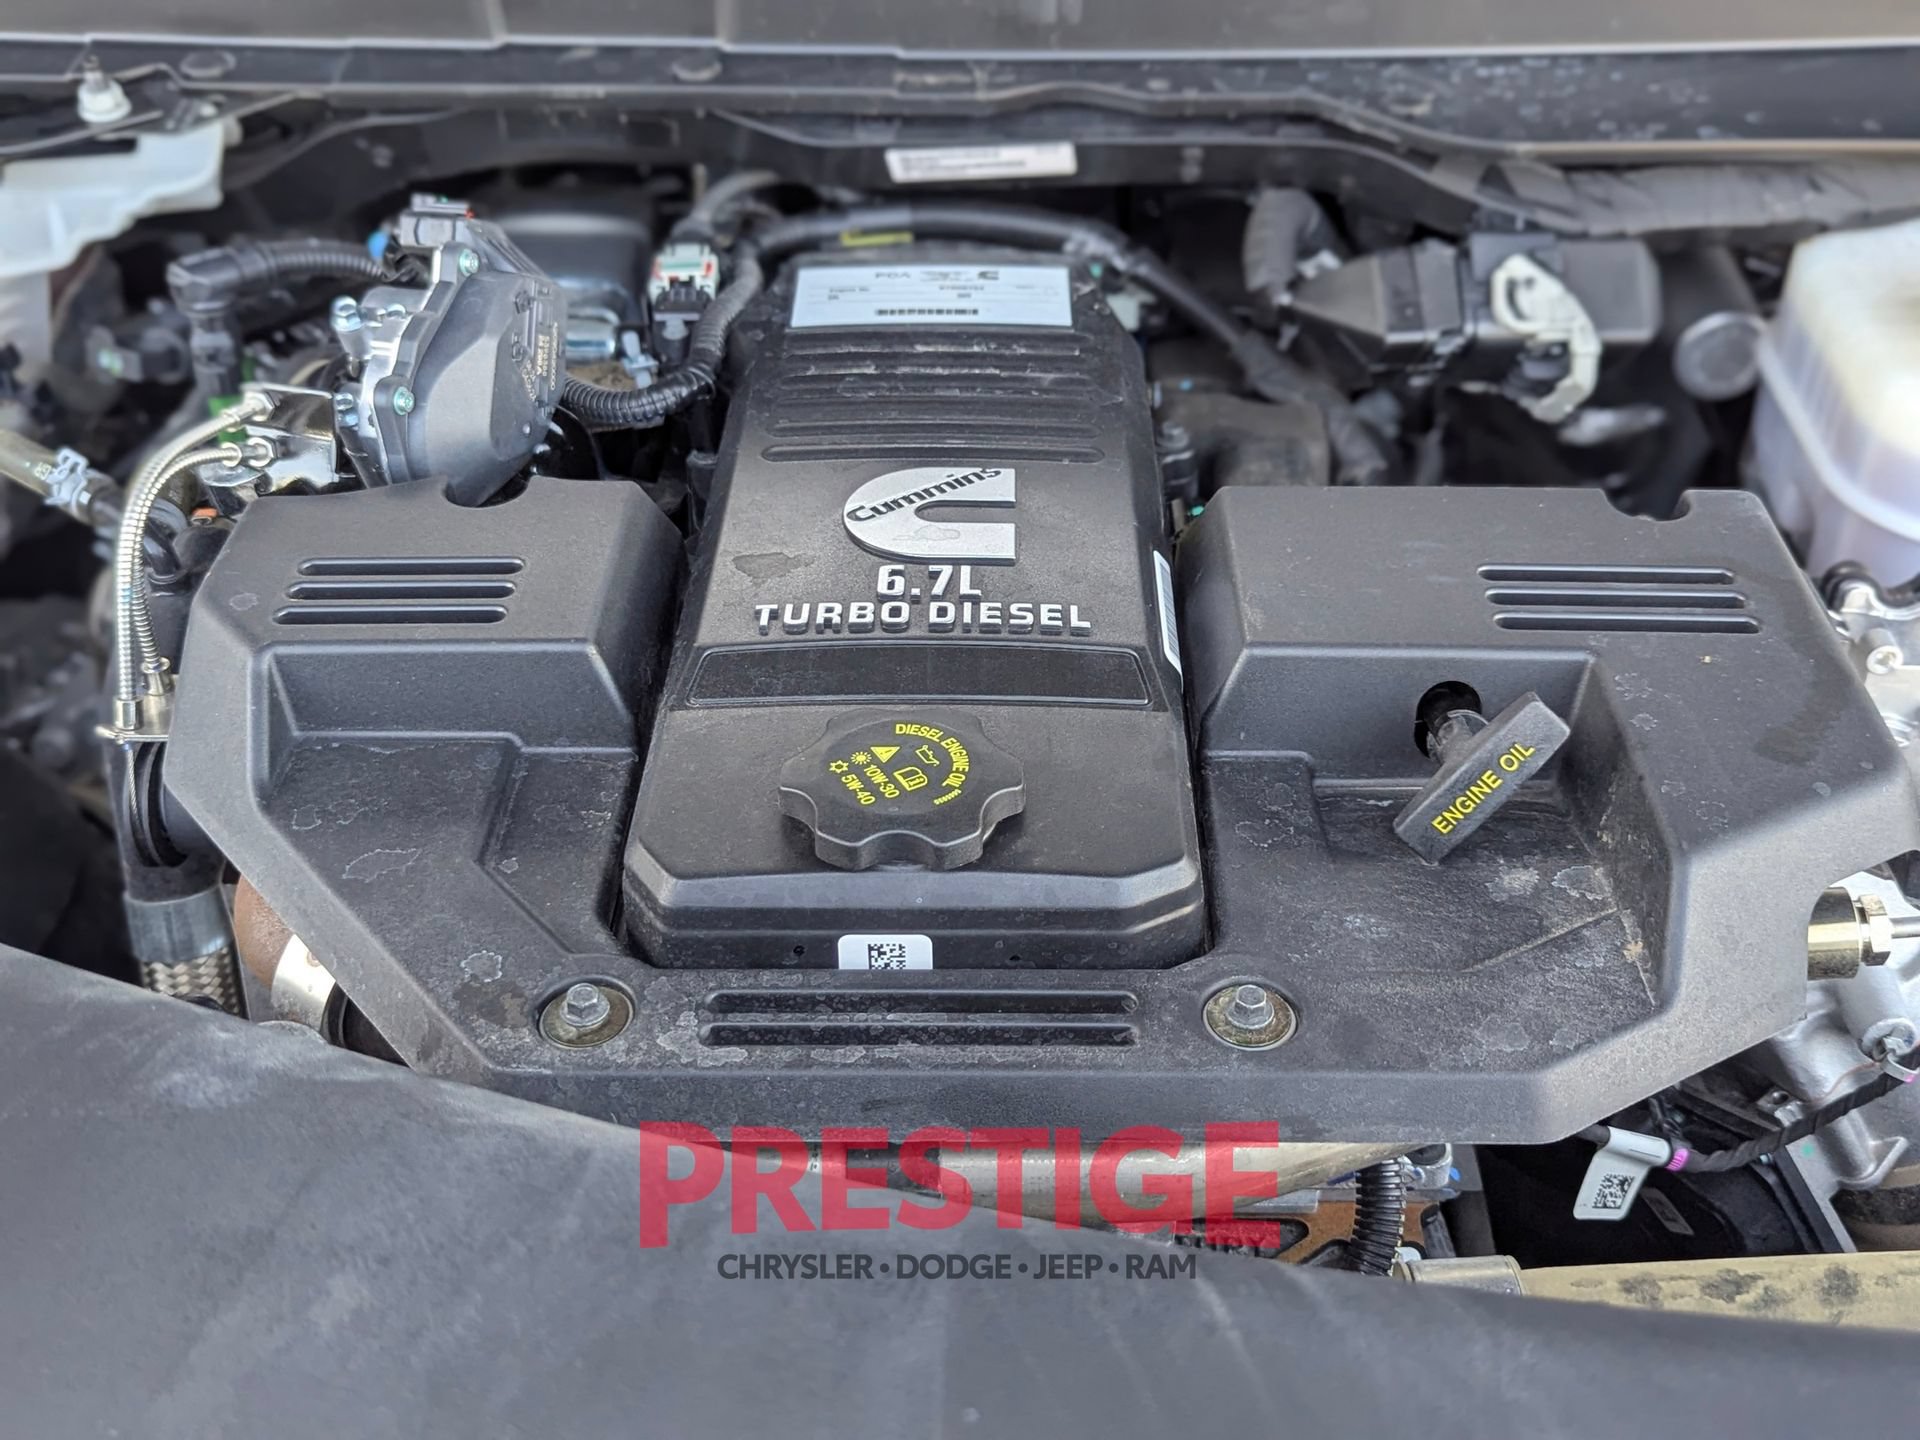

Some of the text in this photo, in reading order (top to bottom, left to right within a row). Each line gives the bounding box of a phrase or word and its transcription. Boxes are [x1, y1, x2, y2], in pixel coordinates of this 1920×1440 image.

[846, 467, 1001, 521] Cummins
[877, 564, 983, 600] 6.7L
[755, 601, 1092, 636] TURBO DIESEL
[895, 723, 944, 743] DIESEL
[941, 737, 970, 773] ENGINE
[841, 773, 876, 805] 5W-40
[863, 764, 900, 798] 10W-30
[942, 772, 967, 789] OIL
[1431, 743, 1536, 834] ENGINE OIL
